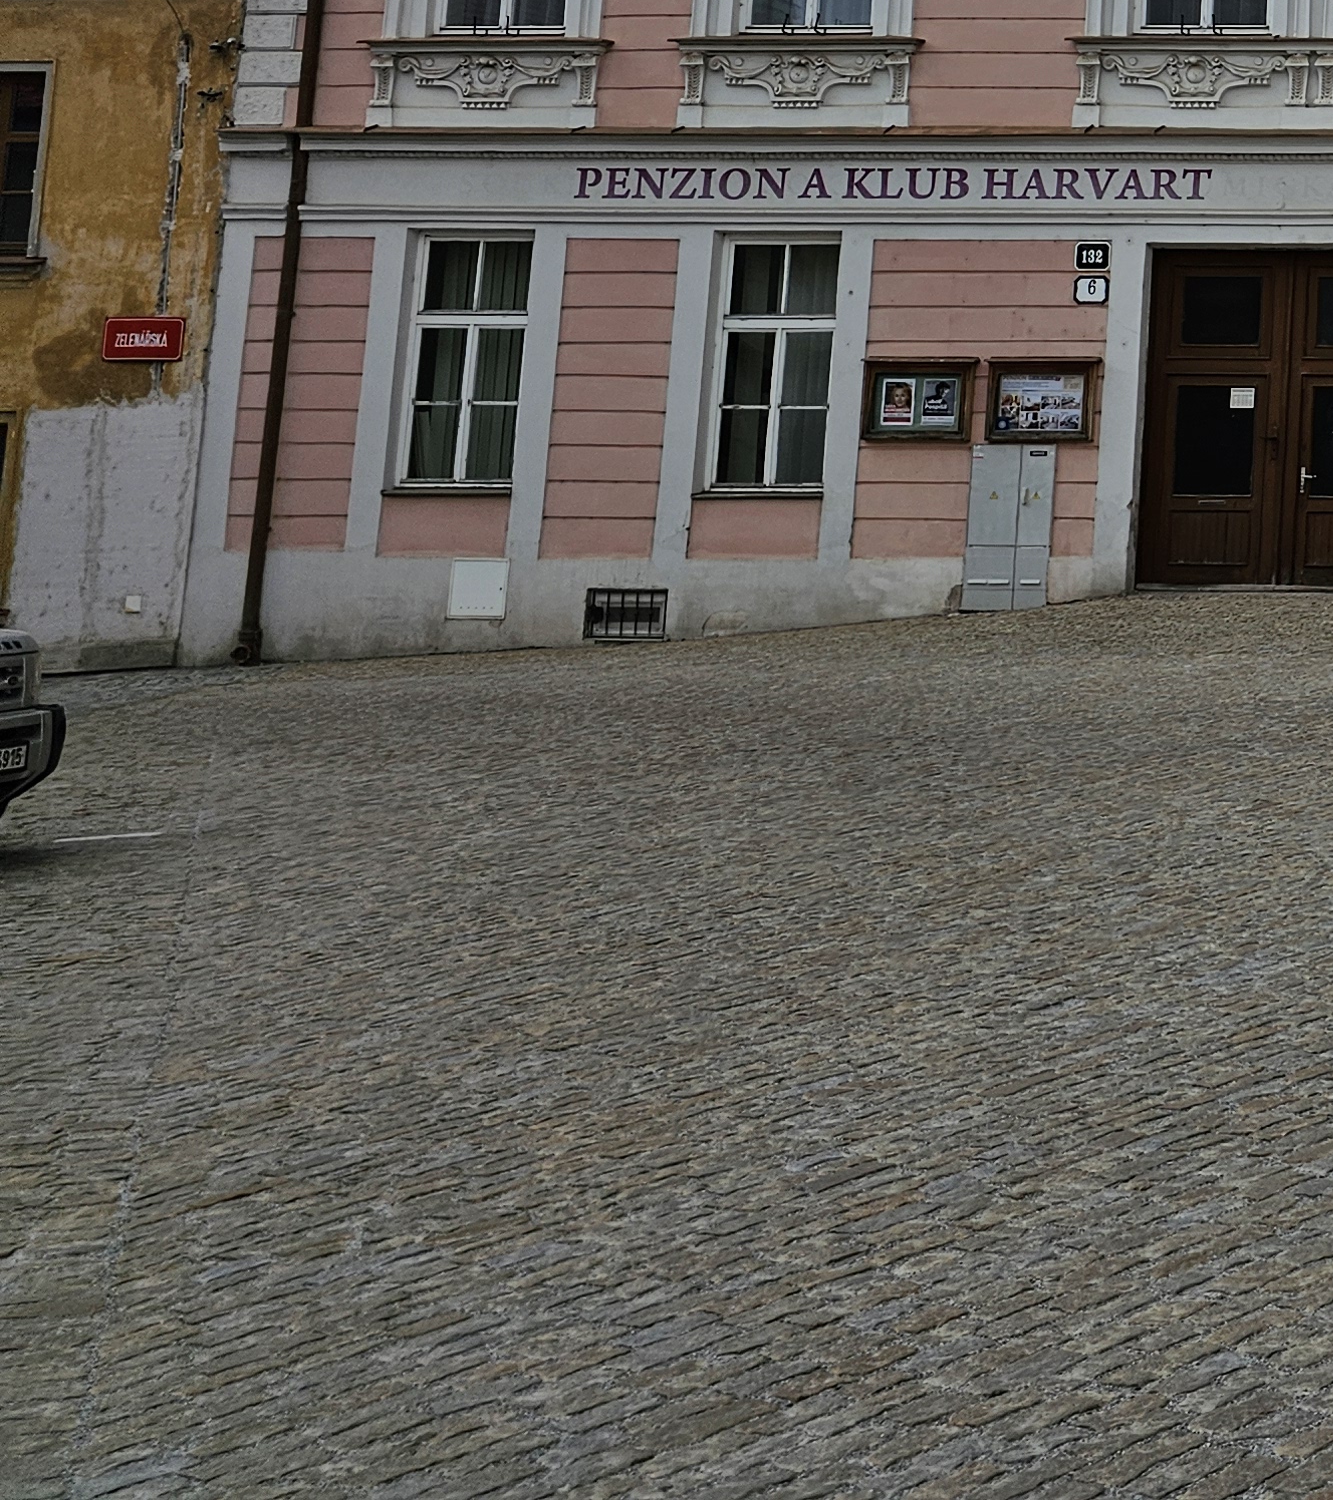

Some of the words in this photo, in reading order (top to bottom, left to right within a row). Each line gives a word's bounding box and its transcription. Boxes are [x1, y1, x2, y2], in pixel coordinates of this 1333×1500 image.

[573, 167, 791, 200] PENZION
[798, 167, 831, 199] A
[842, 167, 970, 200] KLUB
[981, 168, 1213, 200] HARVART
[1081, 249, 1103, 263] 132
[1087, 278, 1097, 295] 6
[114, 330, 168, 347] ZELENÁŘSKÁ
[0, 746, 23, 769] 915
